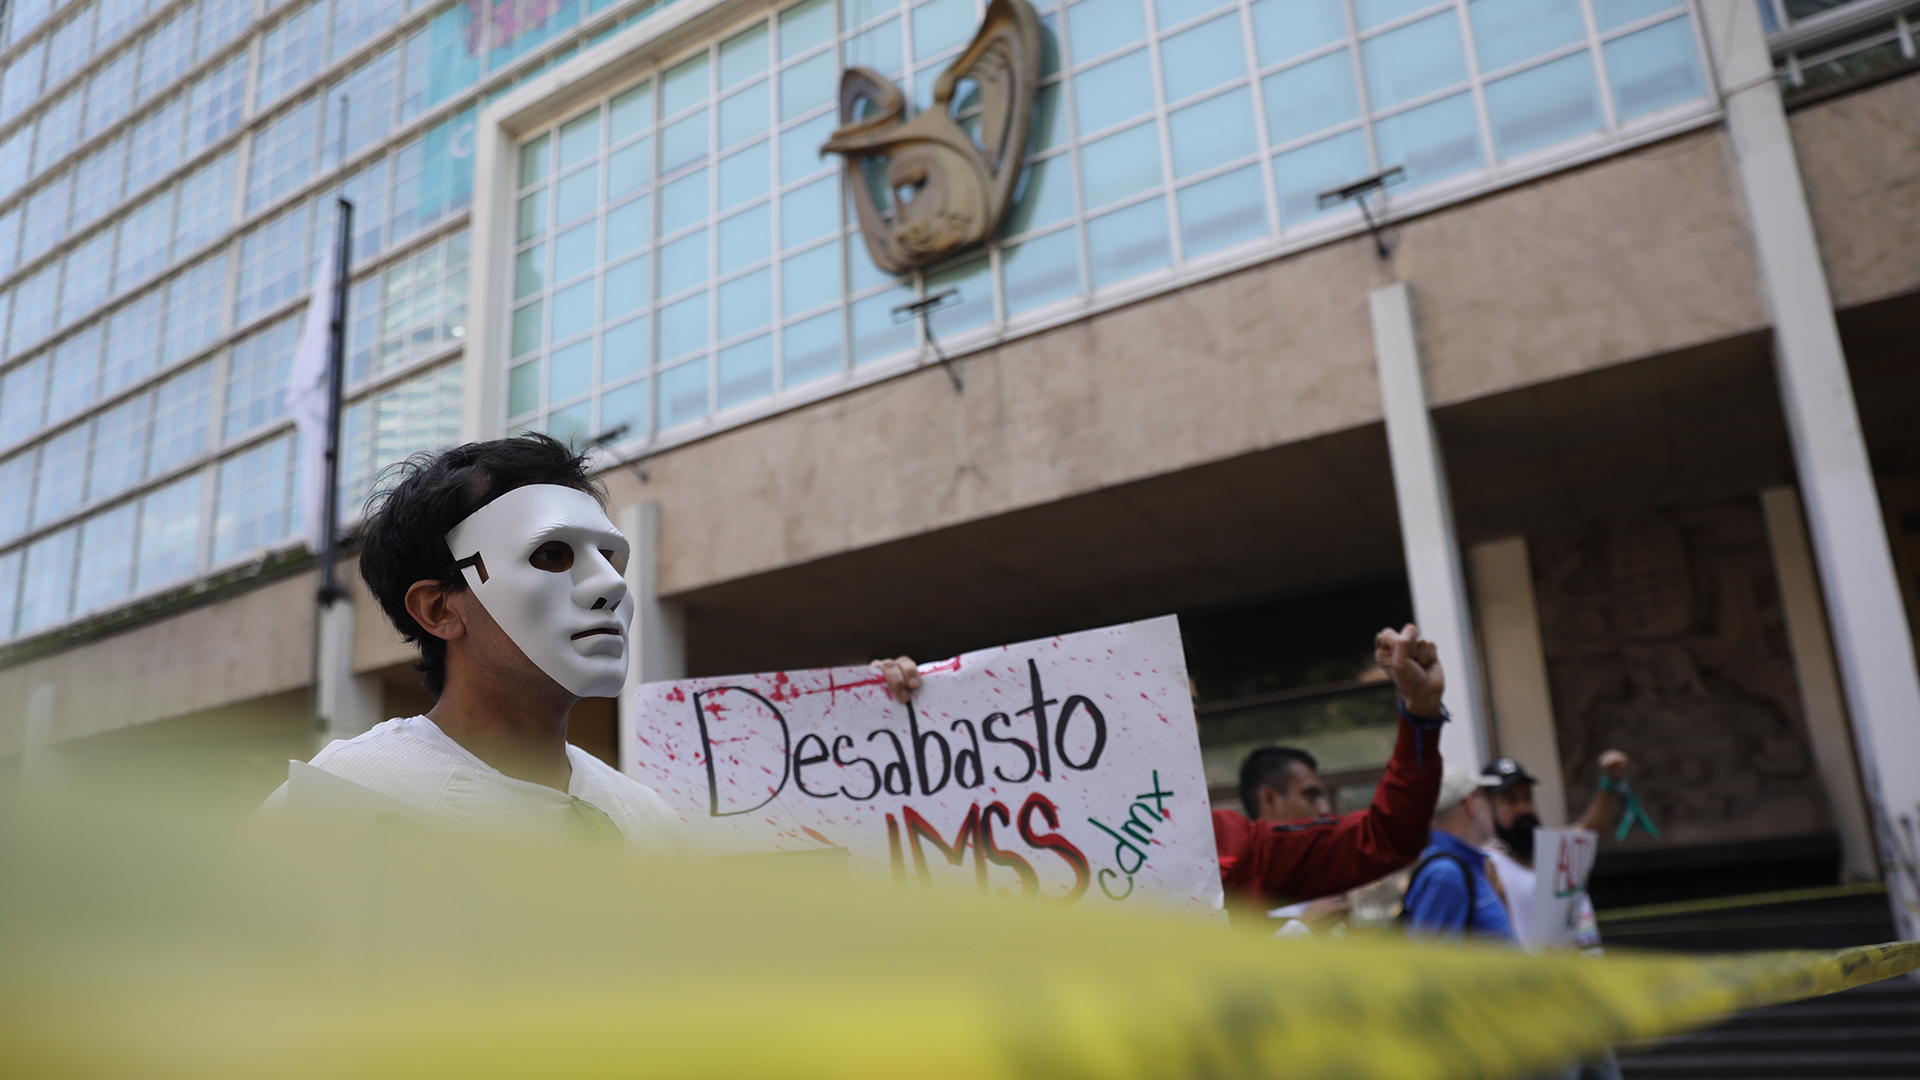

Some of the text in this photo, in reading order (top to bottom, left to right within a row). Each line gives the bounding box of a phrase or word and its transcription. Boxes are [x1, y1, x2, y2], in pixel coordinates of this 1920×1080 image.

[694, 660, 1107, 817] Desabasto
[885, 792, 1092, 906] IMSS
[1088, 770, 1174, 902] cdmx
